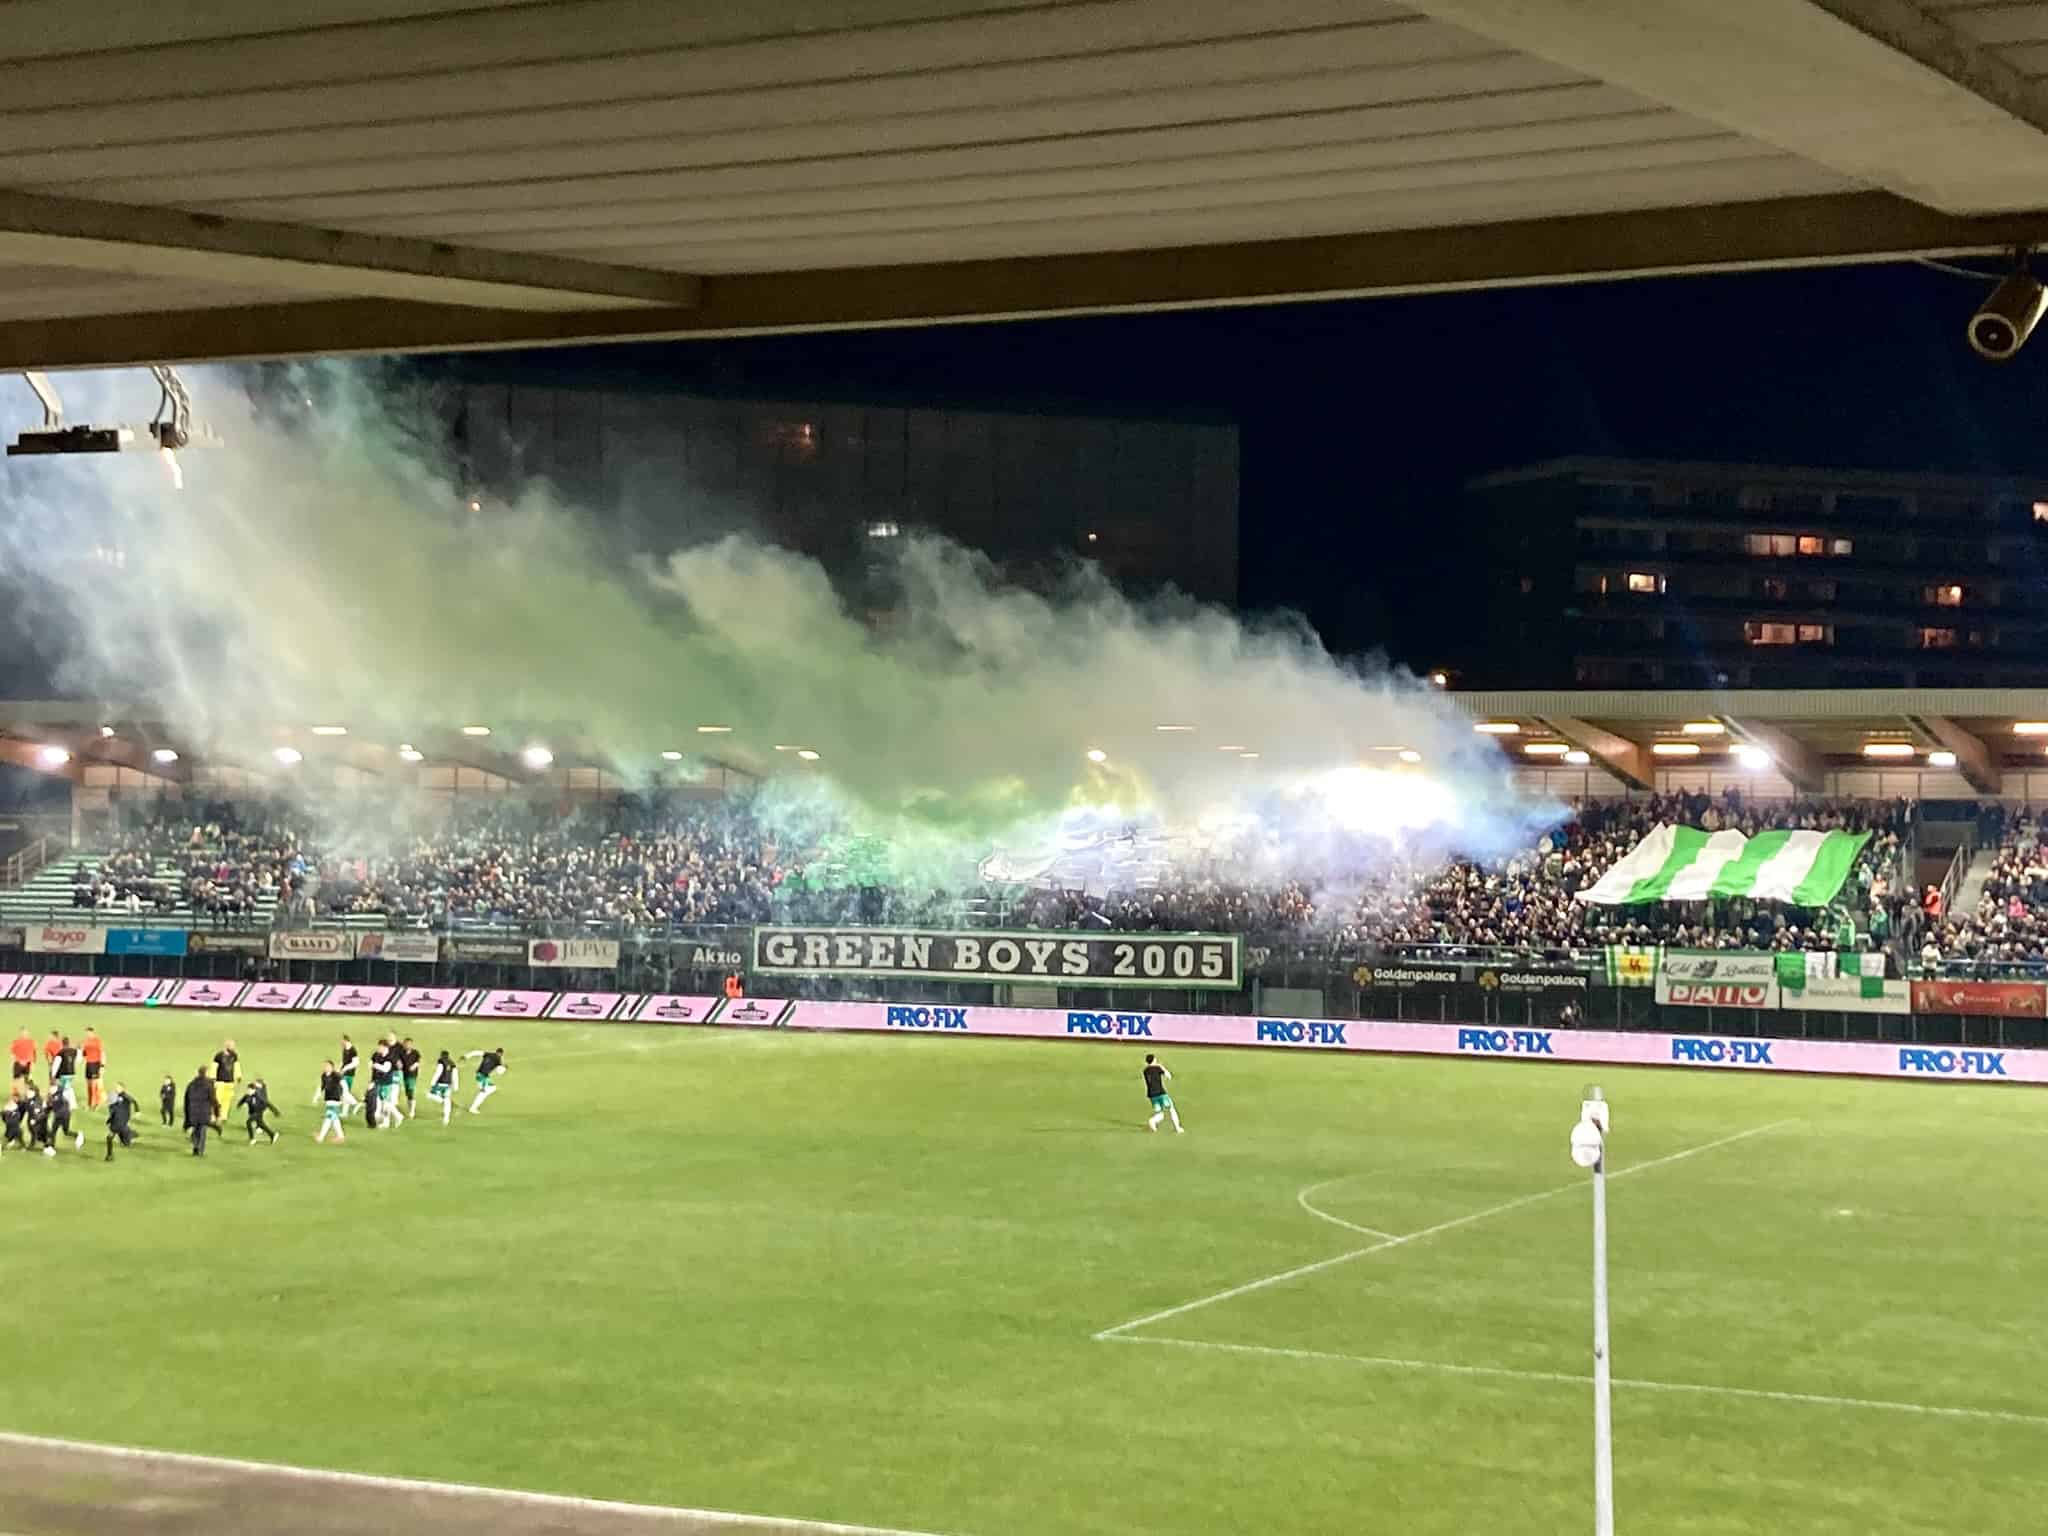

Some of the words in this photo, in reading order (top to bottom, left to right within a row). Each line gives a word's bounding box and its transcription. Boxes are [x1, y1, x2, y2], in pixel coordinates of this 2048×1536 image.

[42, 928, 87, 945] Royco
[692, 946, 742, 964] Akxio
[765, 935, 933, 969] GREEN
[953, 939, 1090, 975] BOYS
[1113, 944, 1224, 977] 2005
[1374, 968, 1457, 982] Goldenpalace
[1500, 973, 1586, 987] Goldenpalace
